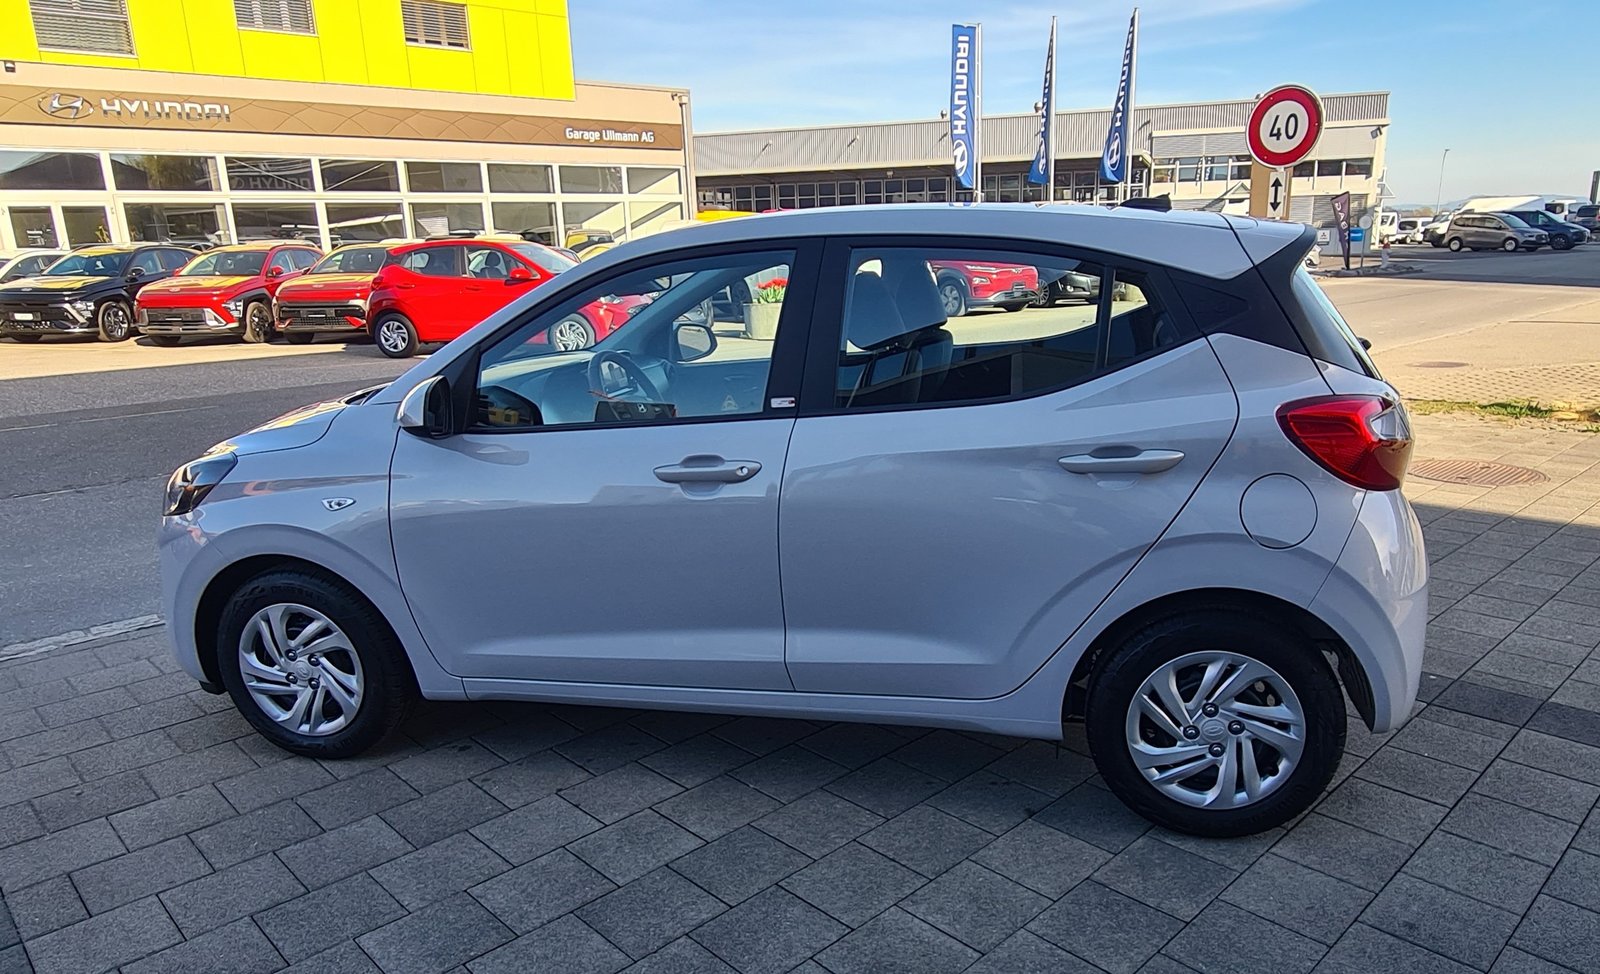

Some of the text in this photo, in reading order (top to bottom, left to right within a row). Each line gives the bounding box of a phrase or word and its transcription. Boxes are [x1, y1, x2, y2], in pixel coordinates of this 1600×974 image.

[100, 97, 231, 122] HYUNDAI
[565, 127, 655, 143] Garage Ullmann AG
[1269, 113, 1299, 141] 40
